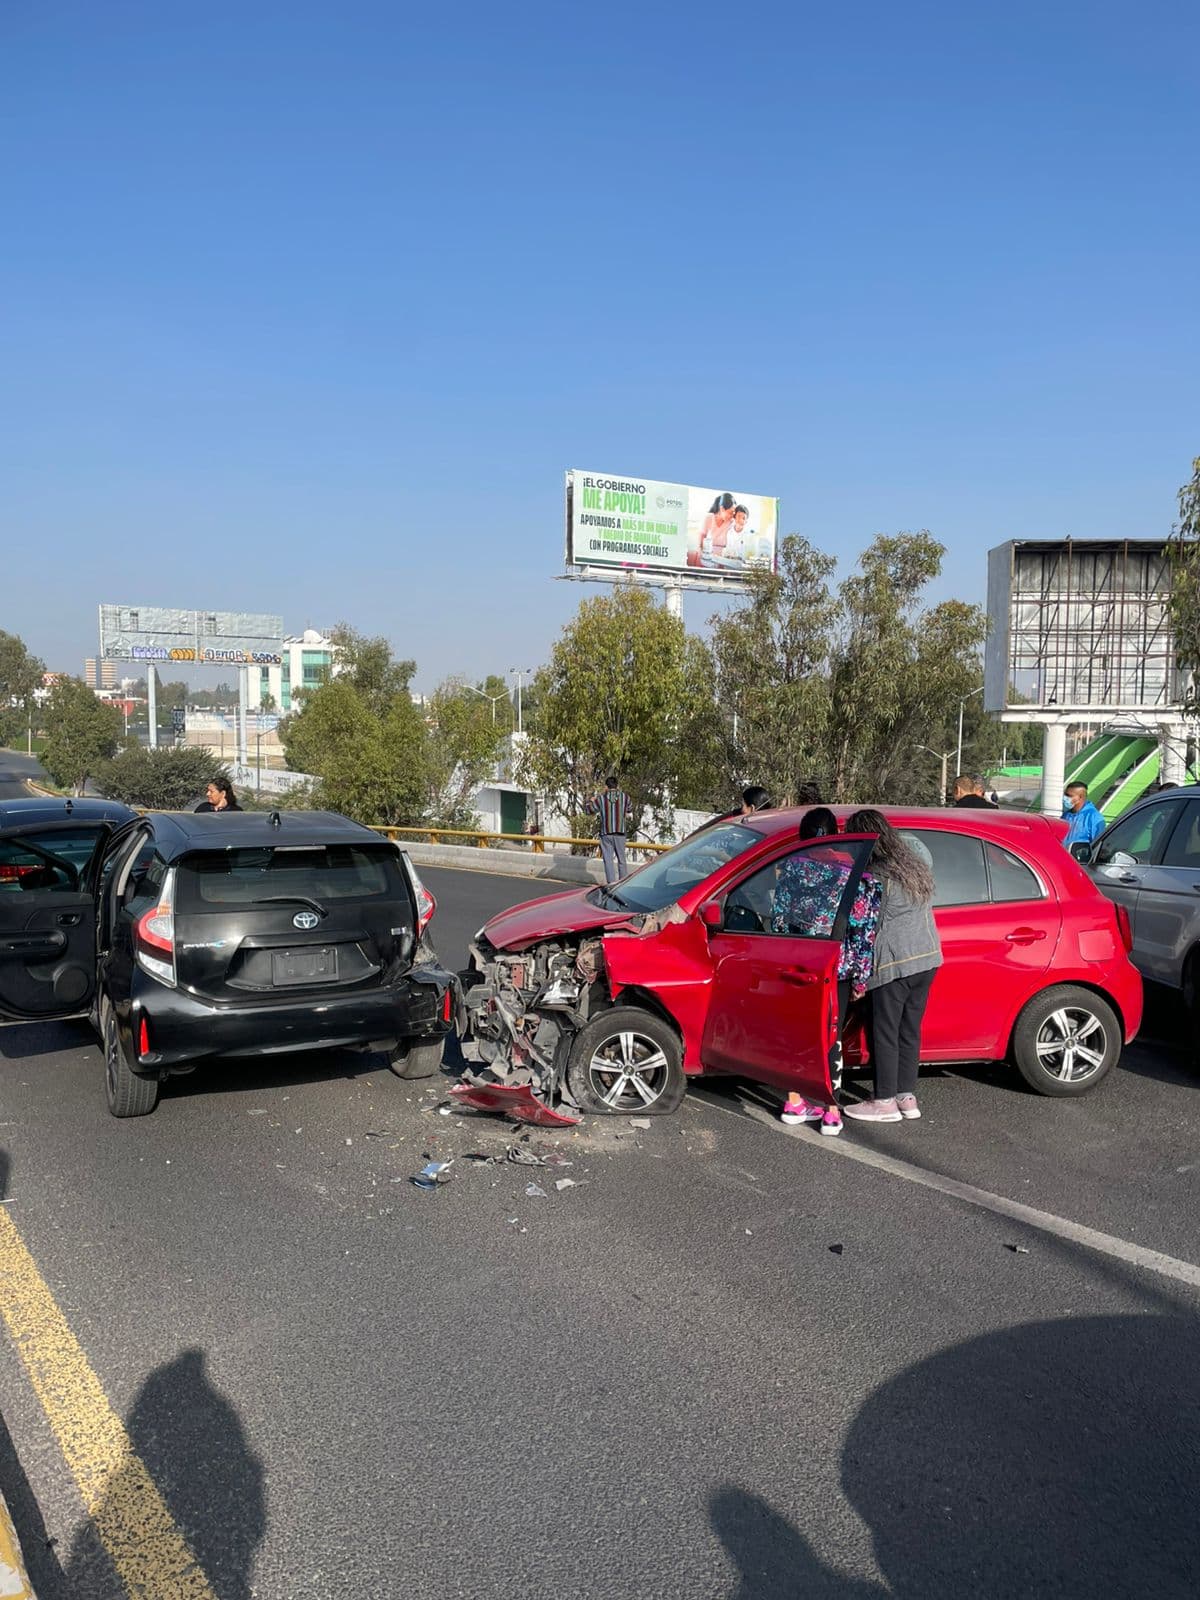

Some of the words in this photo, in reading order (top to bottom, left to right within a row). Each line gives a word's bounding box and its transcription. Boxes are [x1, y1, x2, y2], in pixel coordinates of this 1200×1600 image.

[596, 479, 646, 494] GOBIERNO
[583, 487, 602, 509] ME
[603, 490, 646, 515] APOYA!
[580, 513, 616, 528] APOYAMOS
[616, 518, 621, 529] A
[638, 520, 645, 532] DE
[646, 521, 655, 533] UN
[598, 528, 603, 539] Y
[603, 529, 624, 541] MEDIO
[624, 531, 633, 542] DE
[633, 532, 662, 545] FAMILIAS
[589, 539, 602, 551] CON
[602, 540, 642, 555] PROGRAMAS
[642, 544, 669, 557] SOCIALES
